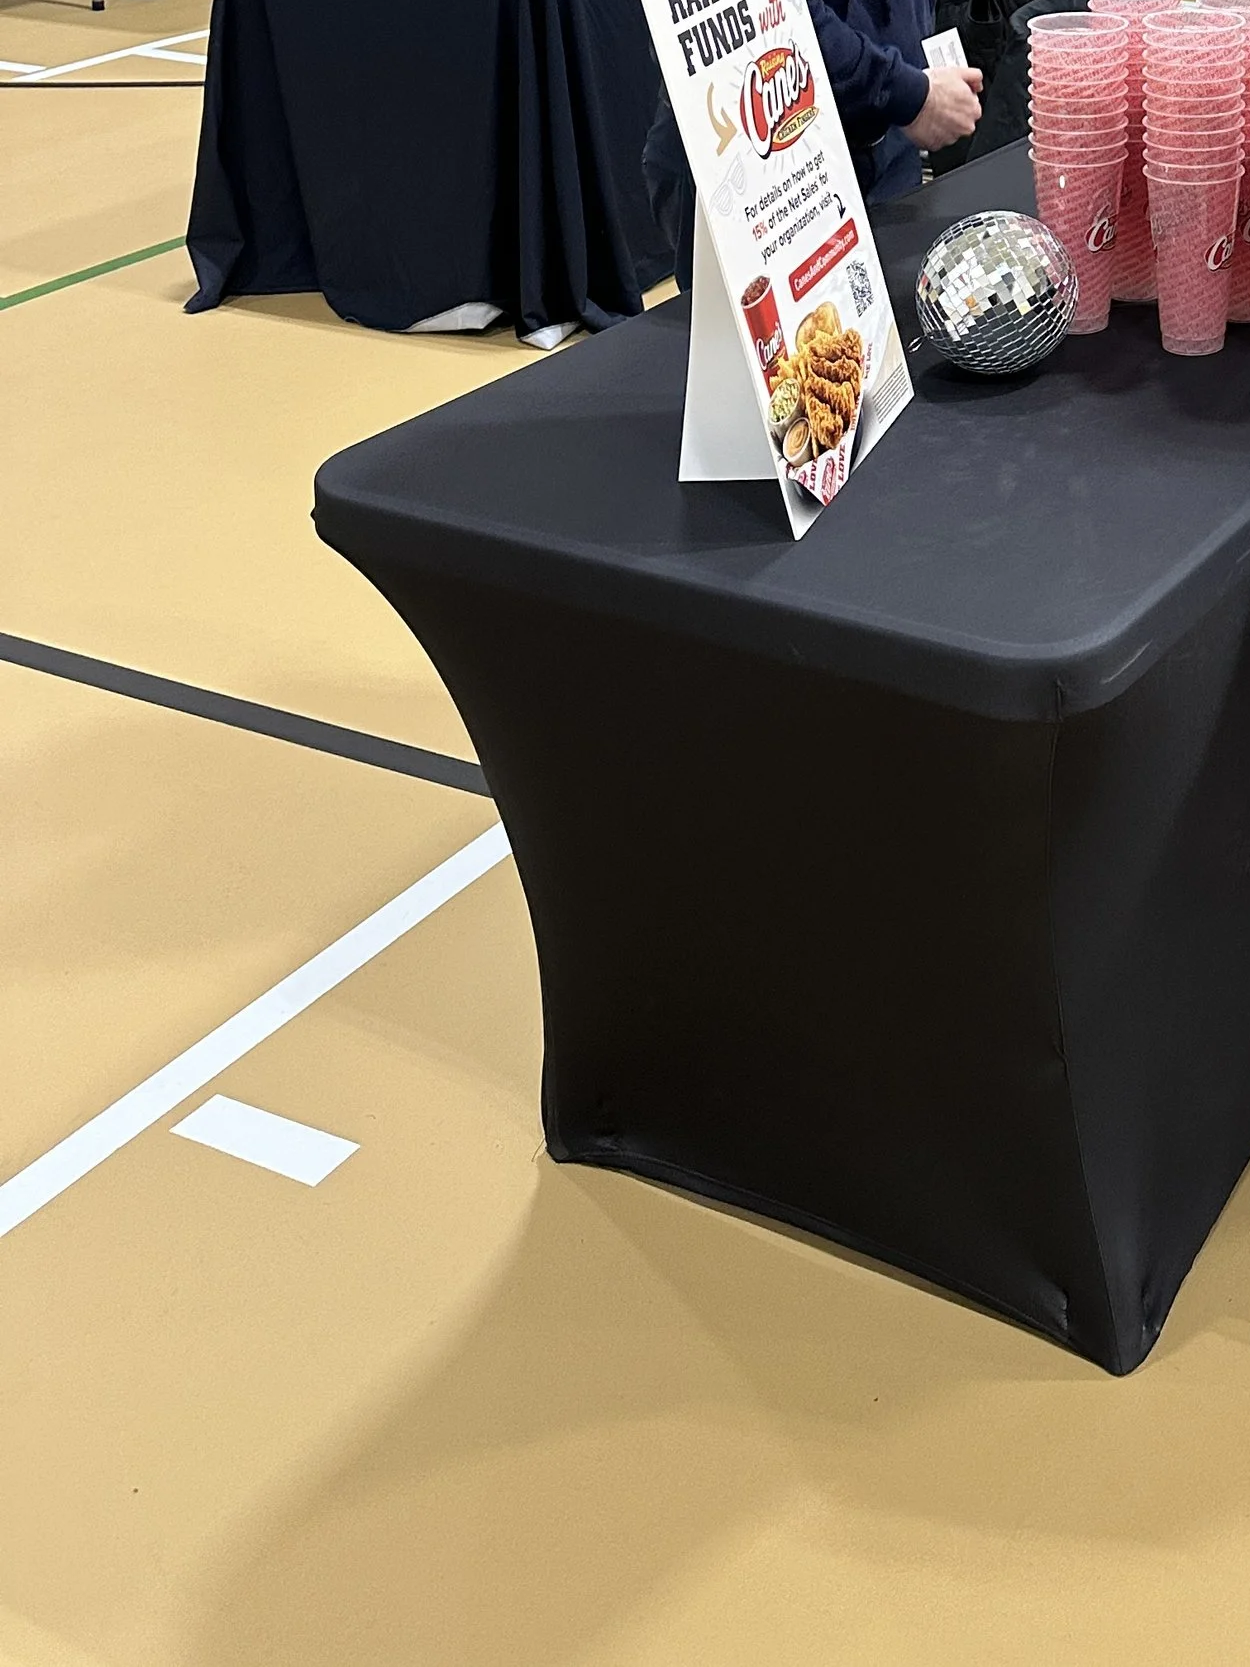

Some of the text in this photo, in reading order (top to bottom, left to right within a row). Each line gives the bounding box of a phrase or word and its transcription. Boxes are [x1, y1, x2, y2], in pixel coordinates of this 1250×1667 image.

[743, 38, 811, 158] Cane's
[760, 51, 786, 79] Raising
[744, 150, 826, 223] For details on how to get
[752, 220, 769, 242] 15%
[768, 213, 777, 230] of
[776, 204, 790, 223] the
[788, 193, 804, 214] Net
[817, 171, 830, 185] for
[760, 191, 834, 266] your organization, visit
